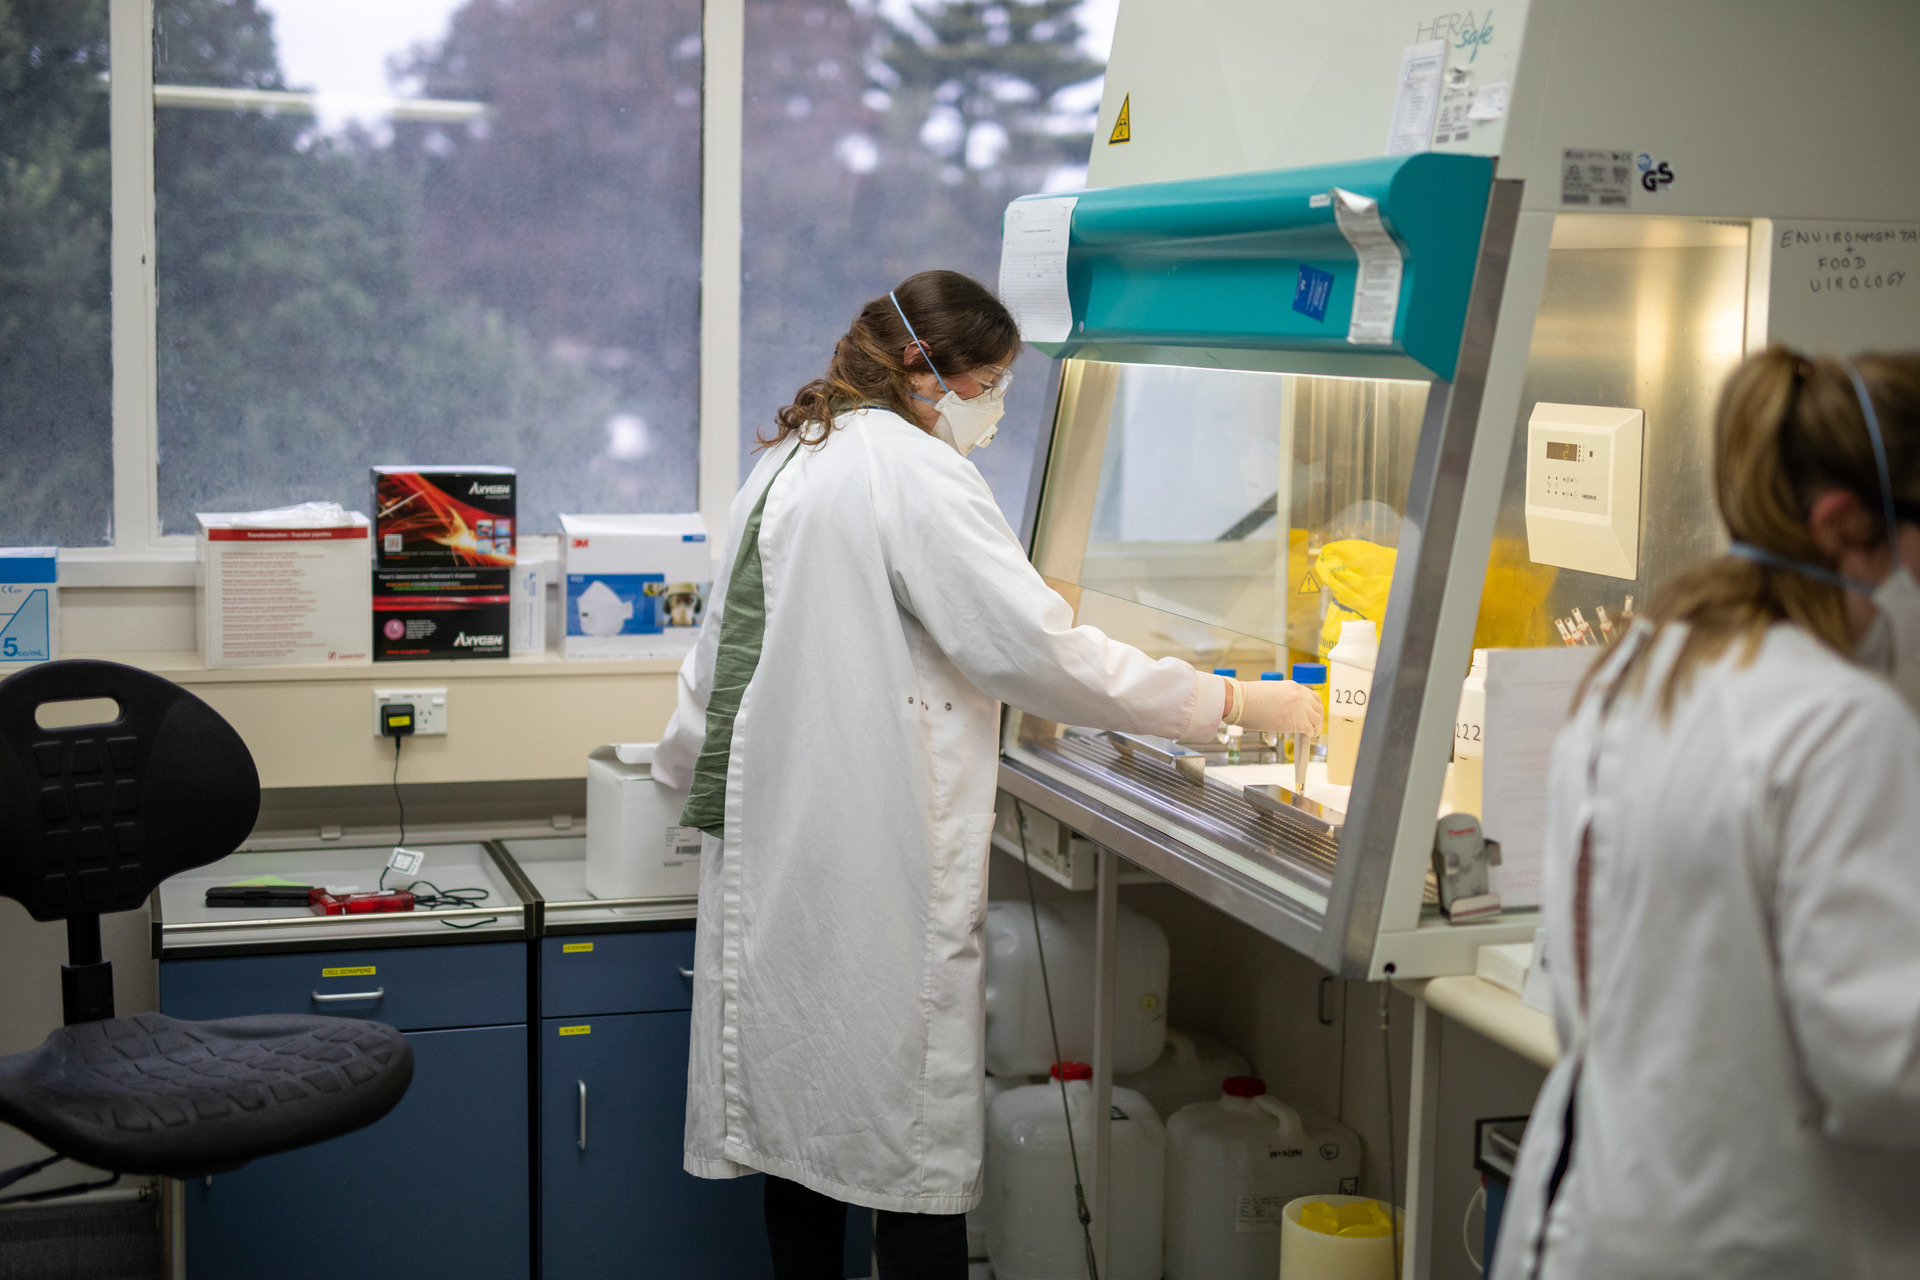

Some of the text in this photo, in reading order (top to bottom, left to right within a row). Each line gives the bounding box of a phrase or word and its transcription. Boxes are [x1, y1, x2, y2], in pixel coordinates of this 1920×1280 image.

[1416, 10, 1476, 43] HERA
[1454, 8, 1494, 63] safe
[1642, 162, 1674, 192] GS
[1818, 256, 1866, 270] FOOD
[571, 539, 589, 548] 3M
[1335, 689, 1367, 706] 220
[340, 967, 372, 975] SCRAPERS
